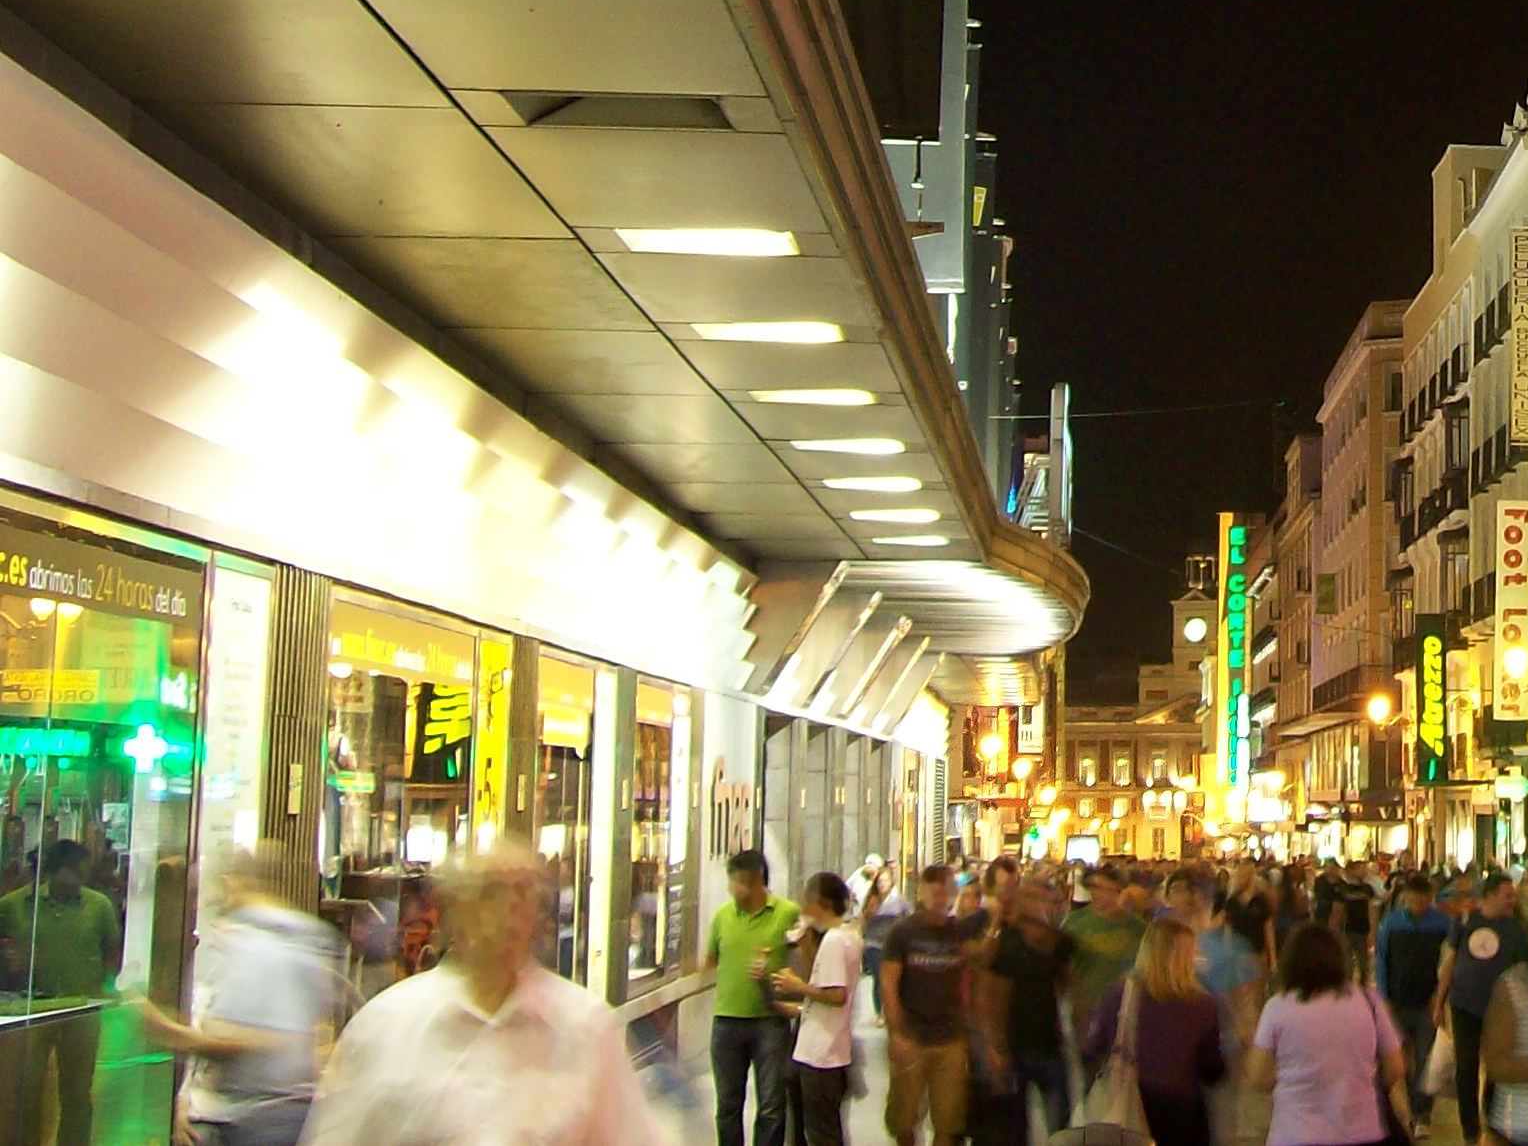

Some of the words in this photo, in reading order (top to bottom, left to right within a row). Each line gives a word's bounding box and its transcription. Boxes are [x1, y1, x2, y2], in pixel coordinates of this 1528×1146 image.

[1229, 527, 1248, 565] EL
[29, 559, 75, 595] abrimos
[77, 568, 93, 599] las
[95, 564, 113, 602] 24
[116, 567, 154, 611] horas
[155, 586, 170, 613] del
[1228, 574, 1246, 668] CORTE
[1501, 608, 1528, 717] Loer
